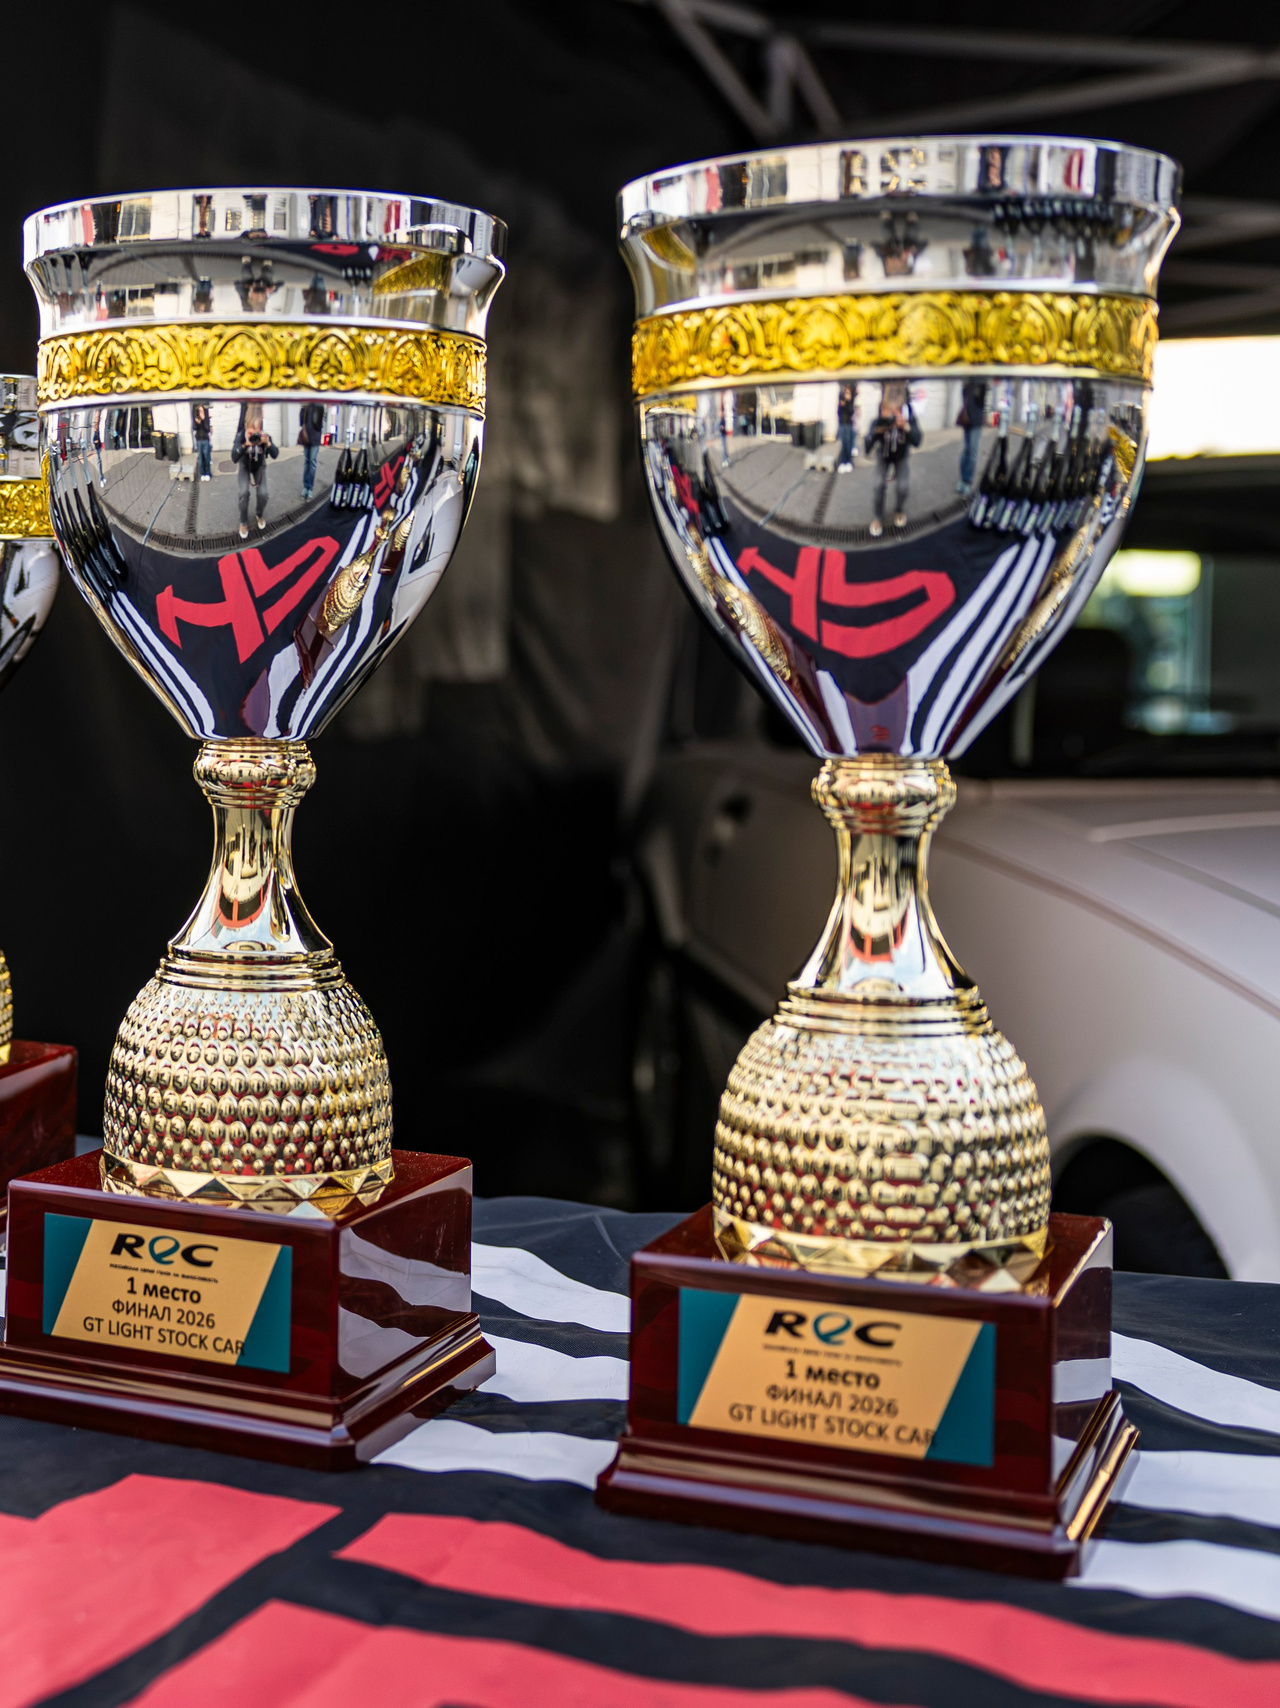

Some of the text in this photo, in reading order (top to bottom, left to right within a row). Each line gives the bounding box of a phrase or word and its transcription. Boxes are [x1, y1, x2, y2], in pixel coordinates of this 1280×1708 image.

[126, 1276, 201, 1304] 1 место
[112, 1299, 215, 1329] ФИНАЛ 2026
[83, 1316, 104, 1333] GT
[108, 1320, 154, 1341] LIGHT
[158, 1328, 208, 1350] STOCK
[785, 1359, 880, 1390] 1 место
[766, 1384, 899, 1419] ФИНАЛ 2026
[728, 1403, 757, 1423] GT
[761, 1406, 818, 1434] LIGHT
[825, 1416, 889, 1441] STOCK
